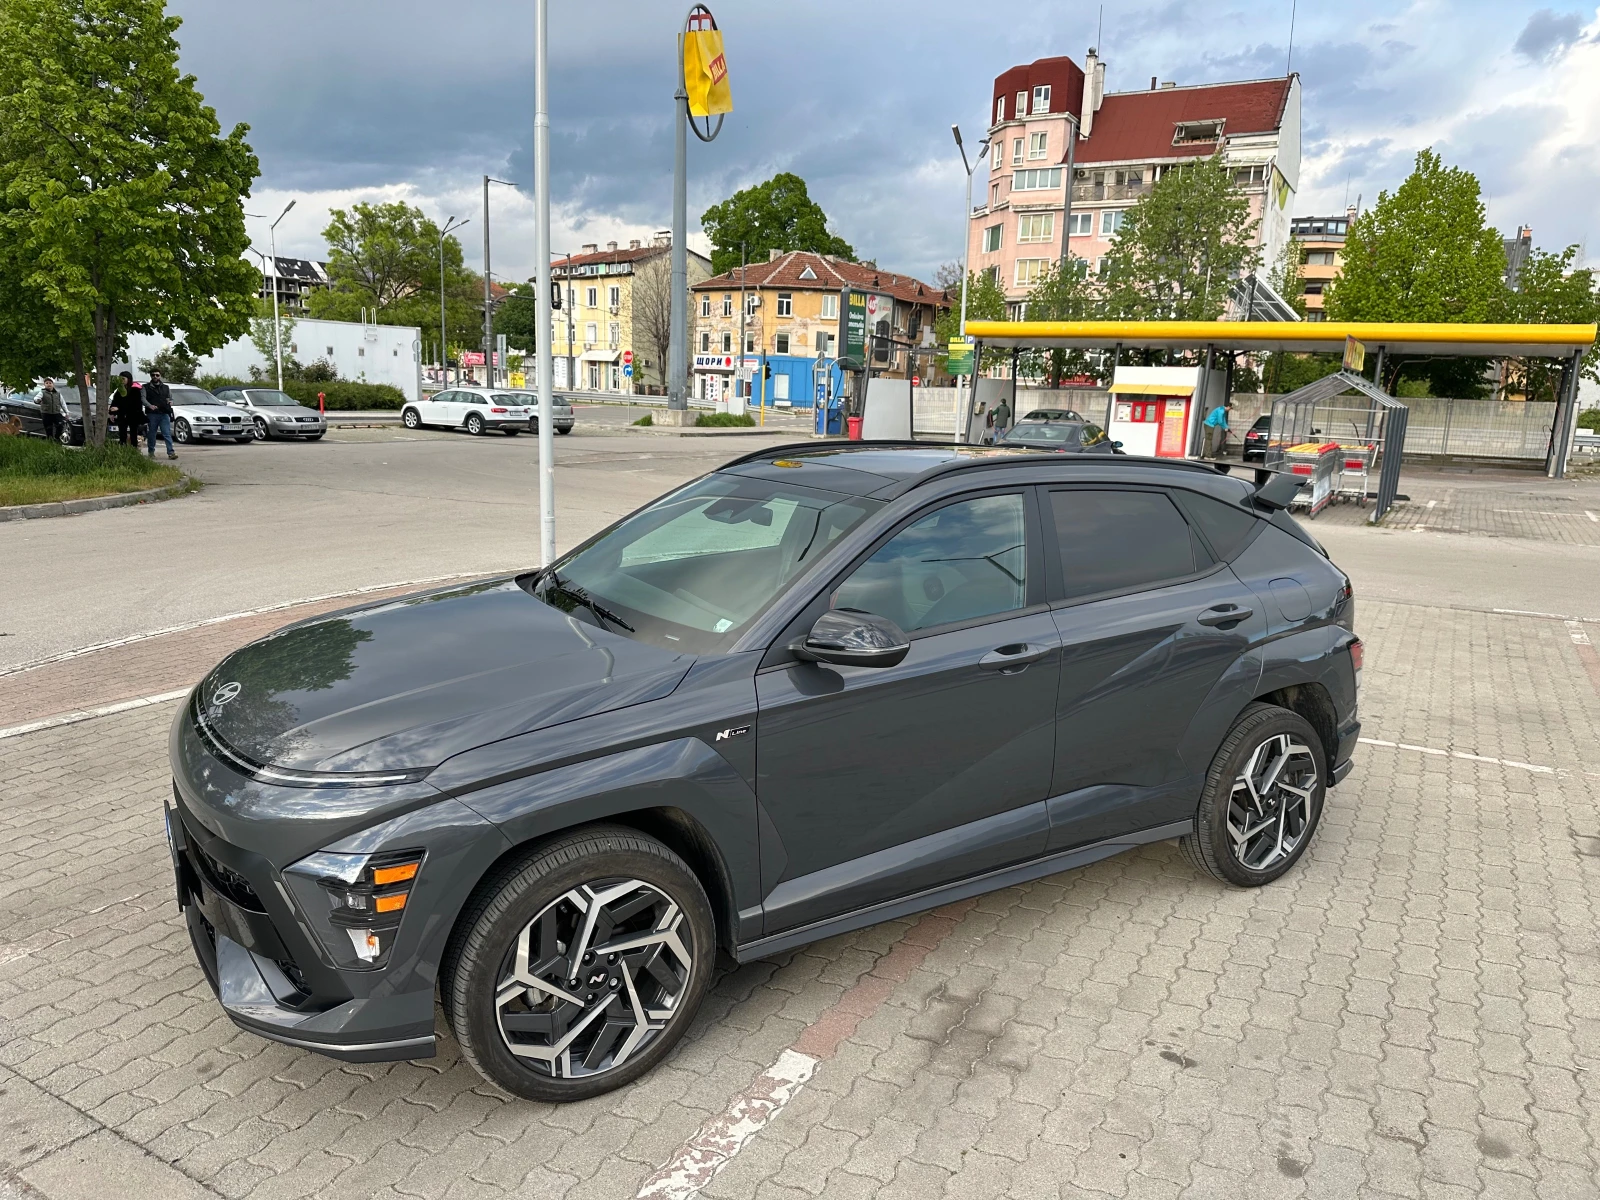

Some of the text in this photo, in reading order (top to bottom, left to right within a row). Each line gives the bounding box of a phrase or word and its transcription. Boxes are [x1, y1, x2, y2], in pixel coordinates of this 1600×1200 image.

[849, 293, 866, 307] BILLA
[967, 336, 974, 344] P
[696, 357, 723, 366] ЩОРИ
